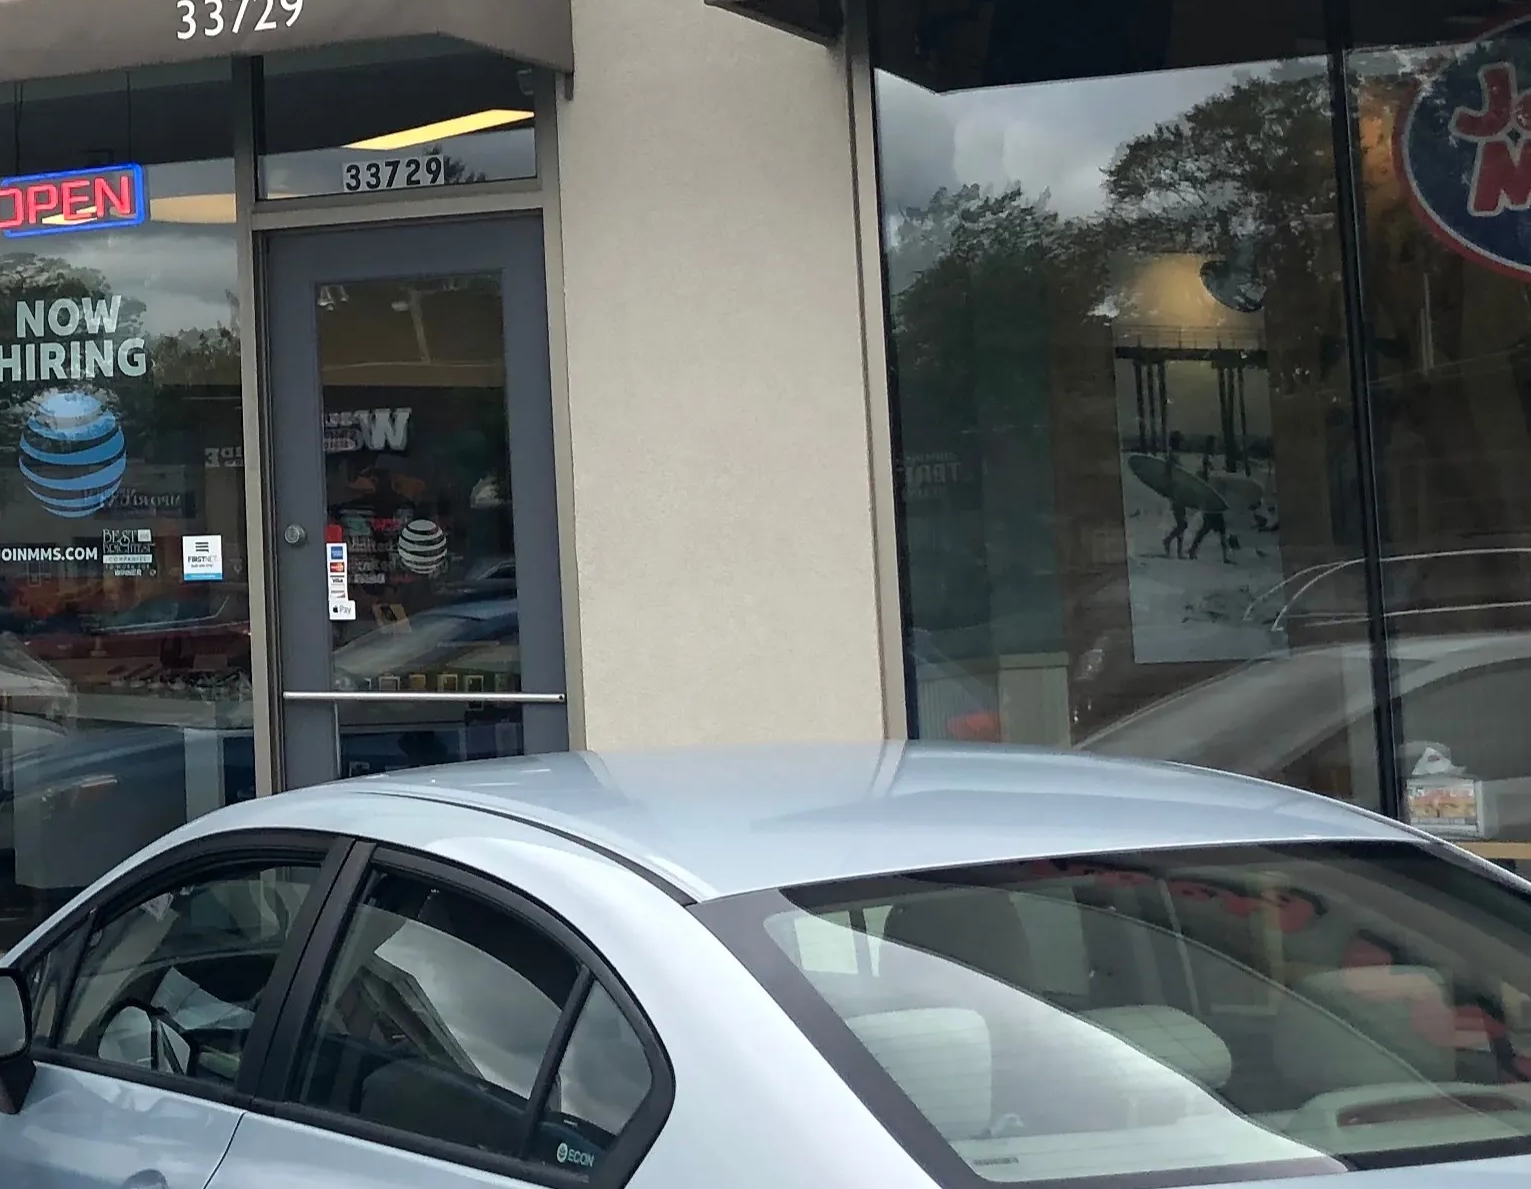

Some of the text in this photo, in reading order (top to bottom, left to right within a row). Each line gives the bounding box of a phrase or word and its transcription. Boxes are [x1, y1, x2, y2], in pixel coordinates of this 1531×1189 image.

[345, 157, 443, 191] 33729
[15, 295, 122, 338] NOW
[339, 606, 352, 615] Pay
